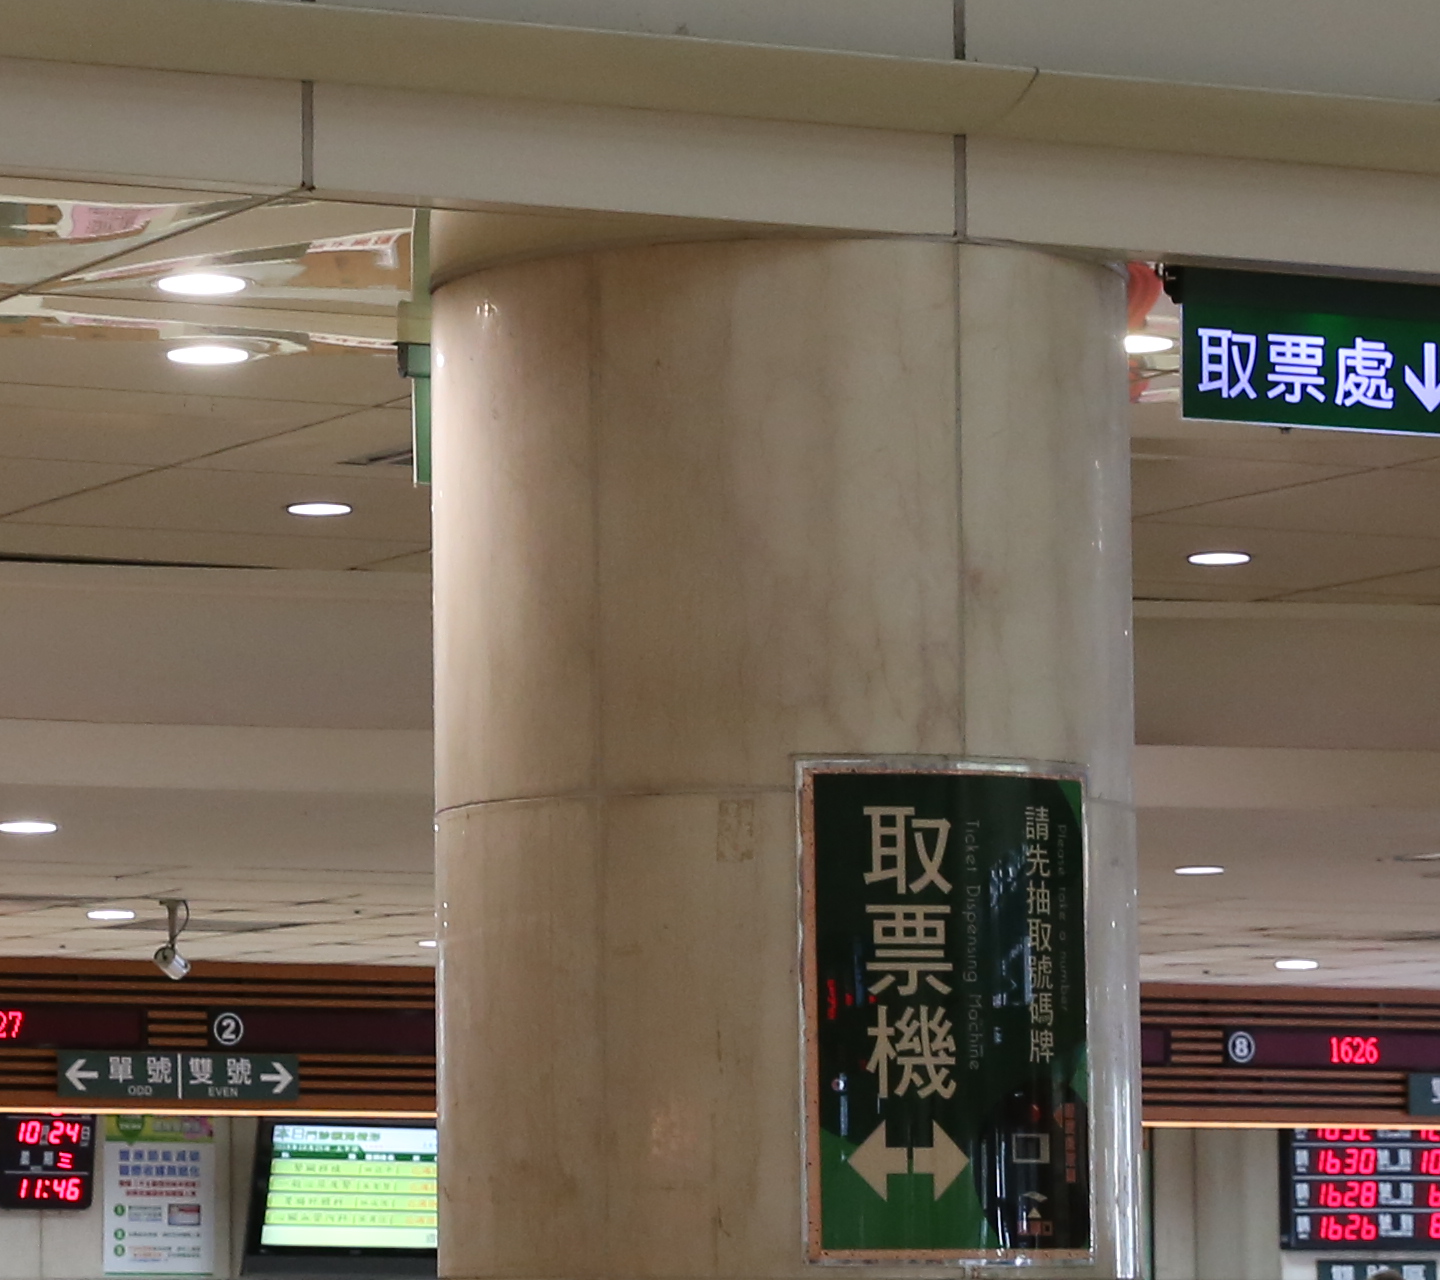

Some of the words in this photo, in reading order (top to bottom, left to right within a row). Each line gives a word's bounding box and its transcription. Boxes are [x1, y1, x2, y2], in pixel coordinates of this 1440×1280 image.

[1197, 327, 1395, 410] 取票處
[966, 819, 980, 872] Ticket
[962, 884, 981, 983] Dispensing
[1024, 806, 1054, 1064] 請先抽取號碼牌
[863, 805, 957, 1100] 取票機
[1330, 1036, 1380, 1065] 1626
[108, 1056, 172, 1084] 單號
[188, 1057, 252, 1085] 雙號
[127, 1085, 154, 1096] ODD
[207, 1086, 239, 1098] EVEN
[1318, 1148, 1377, 1175] 1630
[20, 1178, 81, 1201] 11:46
[1319, 1181, 1377, 1208] 1628
[1320, 1213, 1377, 1240] 1626
